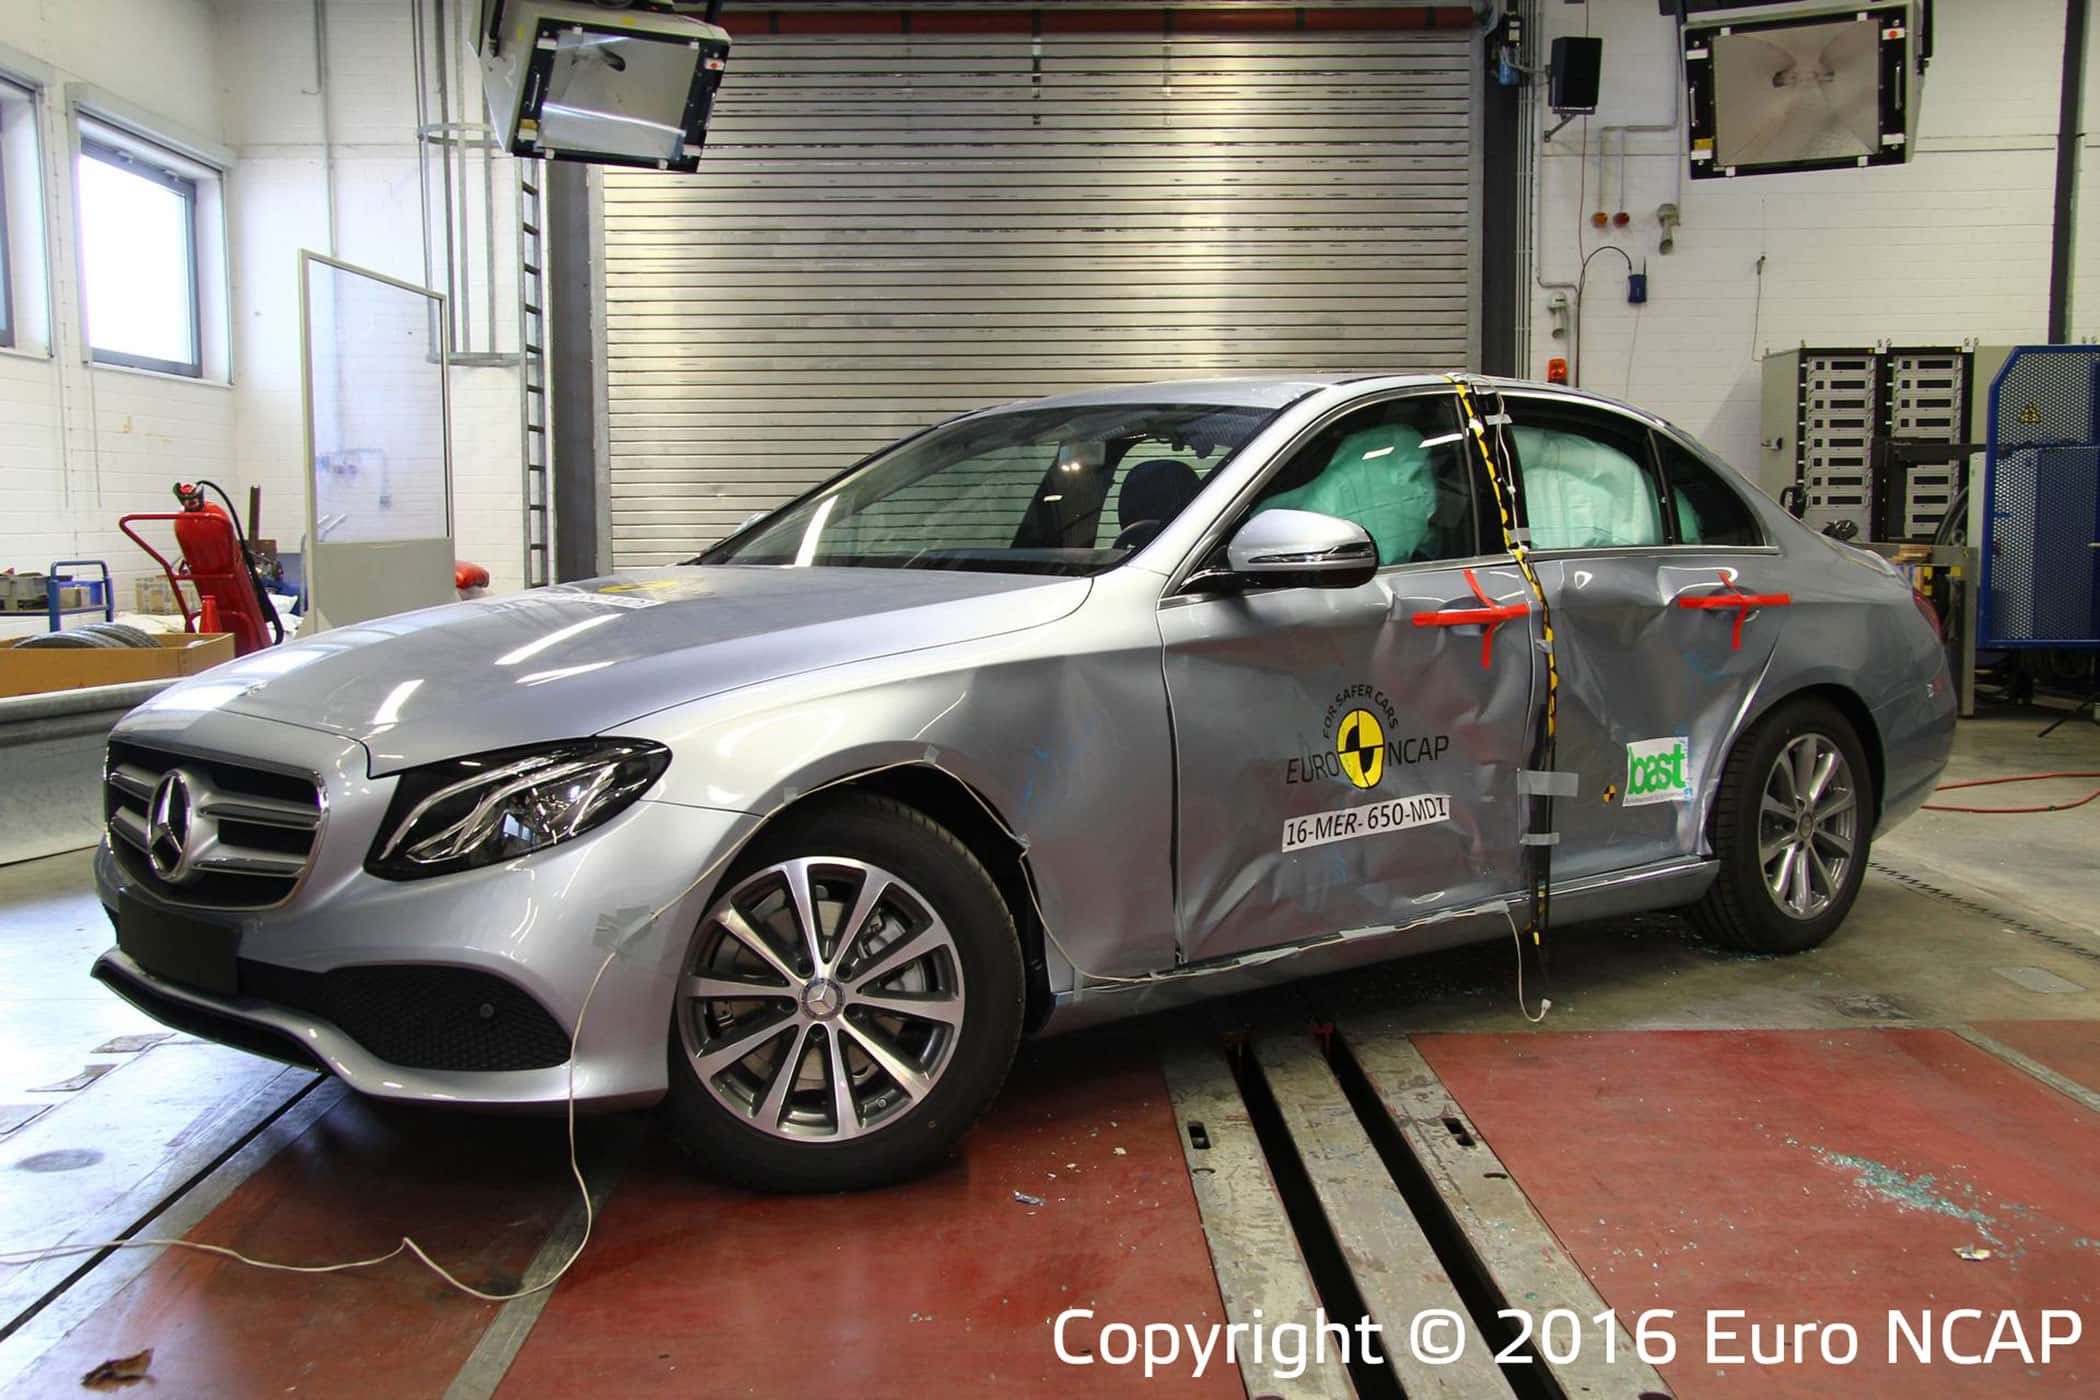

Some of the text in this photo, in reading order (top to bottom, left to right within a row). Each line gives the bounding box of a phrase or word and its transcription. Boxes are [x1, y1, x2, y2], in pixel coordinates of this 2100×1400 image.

[1322, 684, 1399, 740] FOR SAFER CARS
[1286, 735, 1450, 785] EURO NCAP
